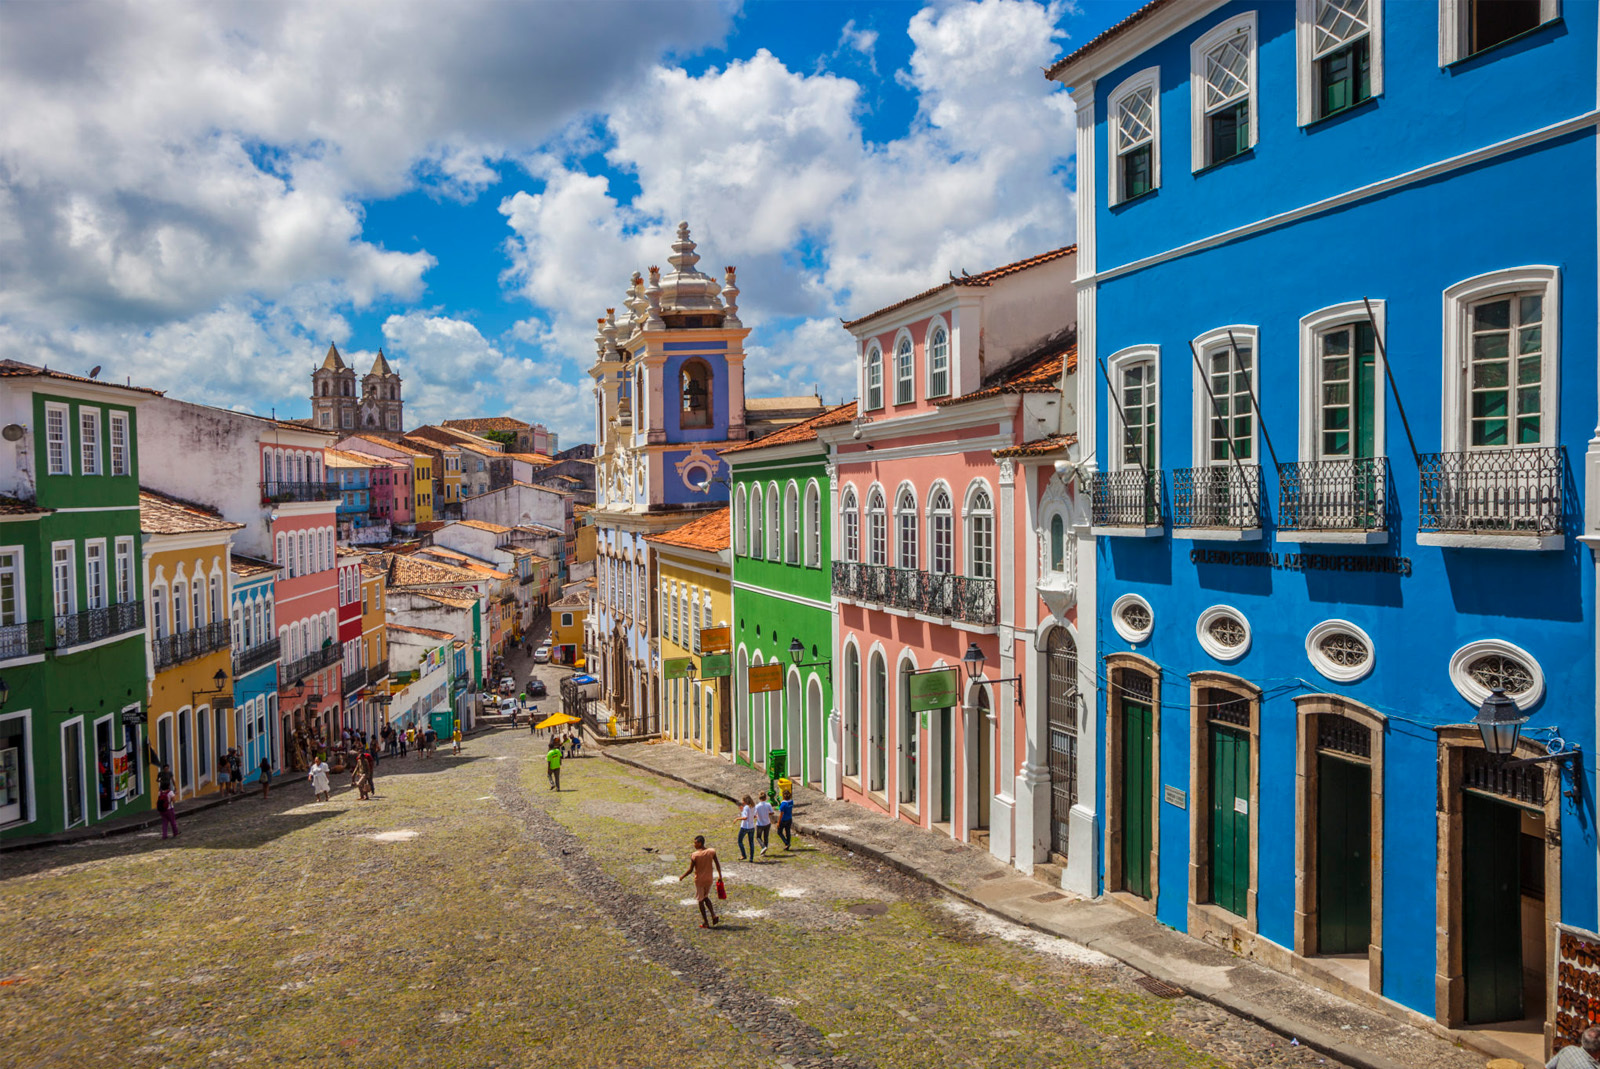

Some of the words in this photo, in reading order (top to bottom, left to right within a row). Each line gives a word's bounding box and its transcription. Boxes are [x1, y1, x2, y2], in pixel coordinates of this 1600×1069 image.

[1231, 551, 1281, 568] ESTADUAL
[1283, 552, 1337, 571] AZEVEDO
[1337, 555, 1411, 576] FERNANDES
